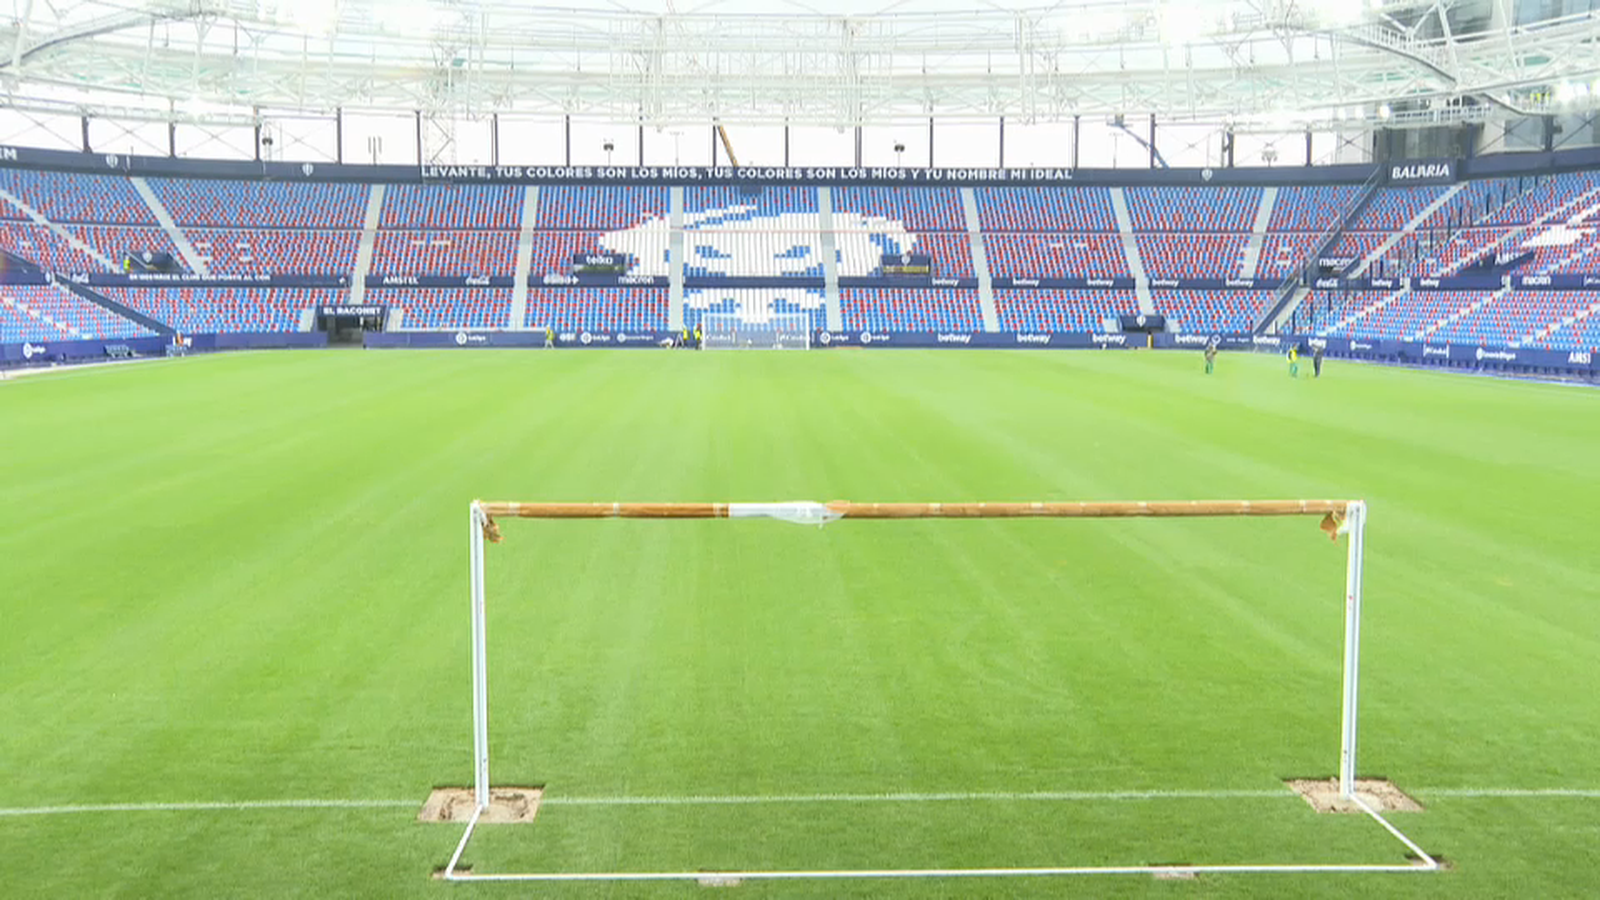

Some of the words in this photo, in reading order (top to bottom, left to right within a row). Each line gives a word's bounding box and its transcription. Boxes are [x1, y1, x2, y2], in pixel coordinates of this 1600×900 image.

[421, 166, 491, 179] LEVANTE,
[497, 167, 523, 178] TUS
[526, 167, 592, 178] COLORES
[597, 167, 626, 178] SON
[632, 167, 658, 178] LOS
[707, 168, 732, 178] TUS
[737, 168, 802, 179] COLORES
[806, 168, 836, 179] SON
[841, 168, 867, 179] LOS
[911, 169, 921, 179] Y
[925, 169, 942, 179] TU
[947, 169, 1005, 180] NOMBRE
[1011, 169, 1026, 180] MI
[1030, 169, 1072, 180] IDEAL
[323, 307, 335, 315] EL
[937, 333, 972, 344] betway
[1016, 333, 1052, 344] betway
[1092, 333, 1127, 345] betway
[1174, 334, 1209, 345] betway
